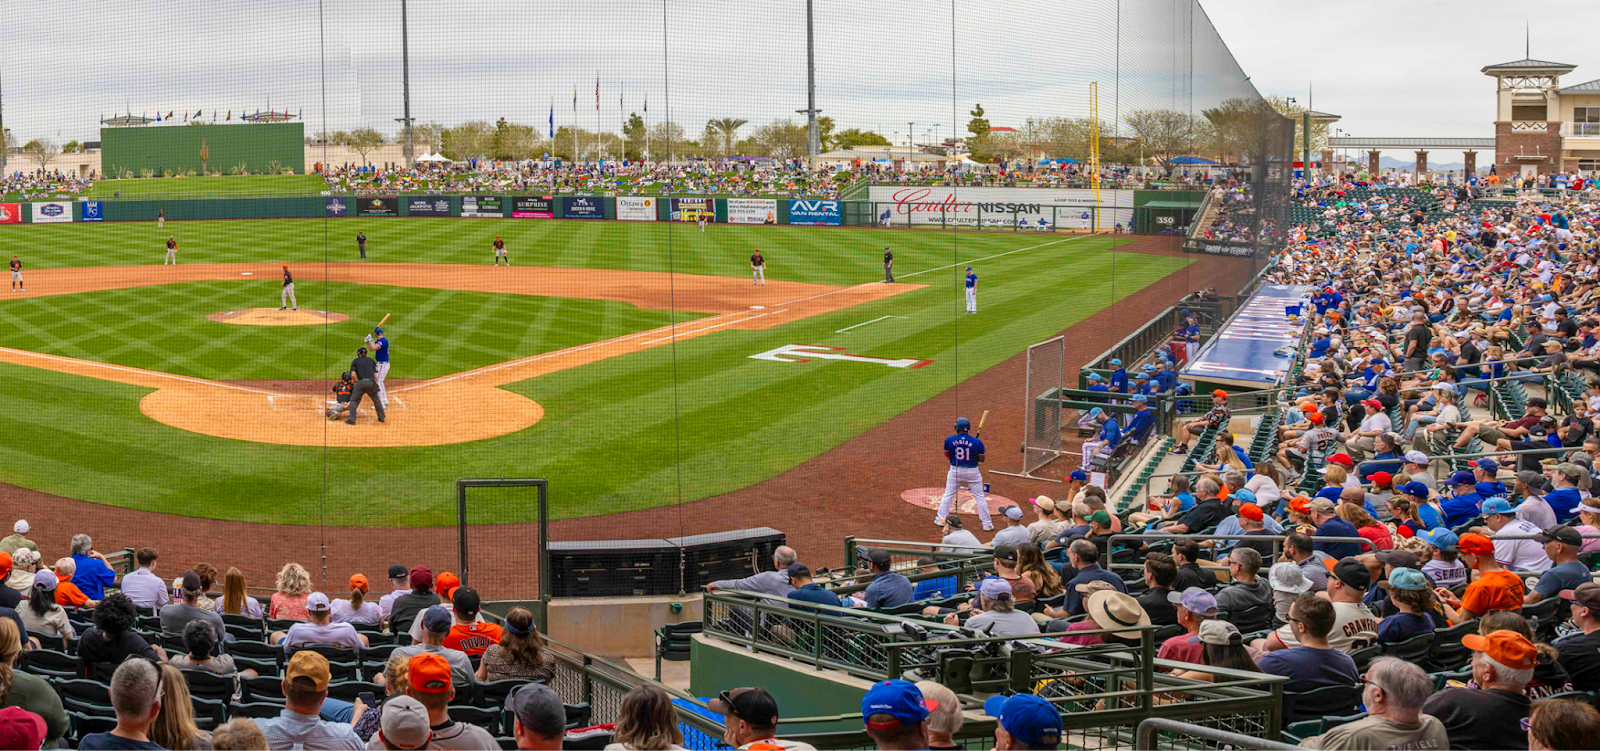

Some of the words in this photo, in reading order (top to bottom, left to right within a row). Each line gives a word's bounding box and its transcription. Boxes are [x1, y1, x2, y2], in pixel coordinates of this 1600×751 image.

[791, 201, 838, 211] AVR
[893, 188, 972, 215] Coulter
[978, 202, 1040, 214] NISSAN
[955, 447, 970, 461] 81
